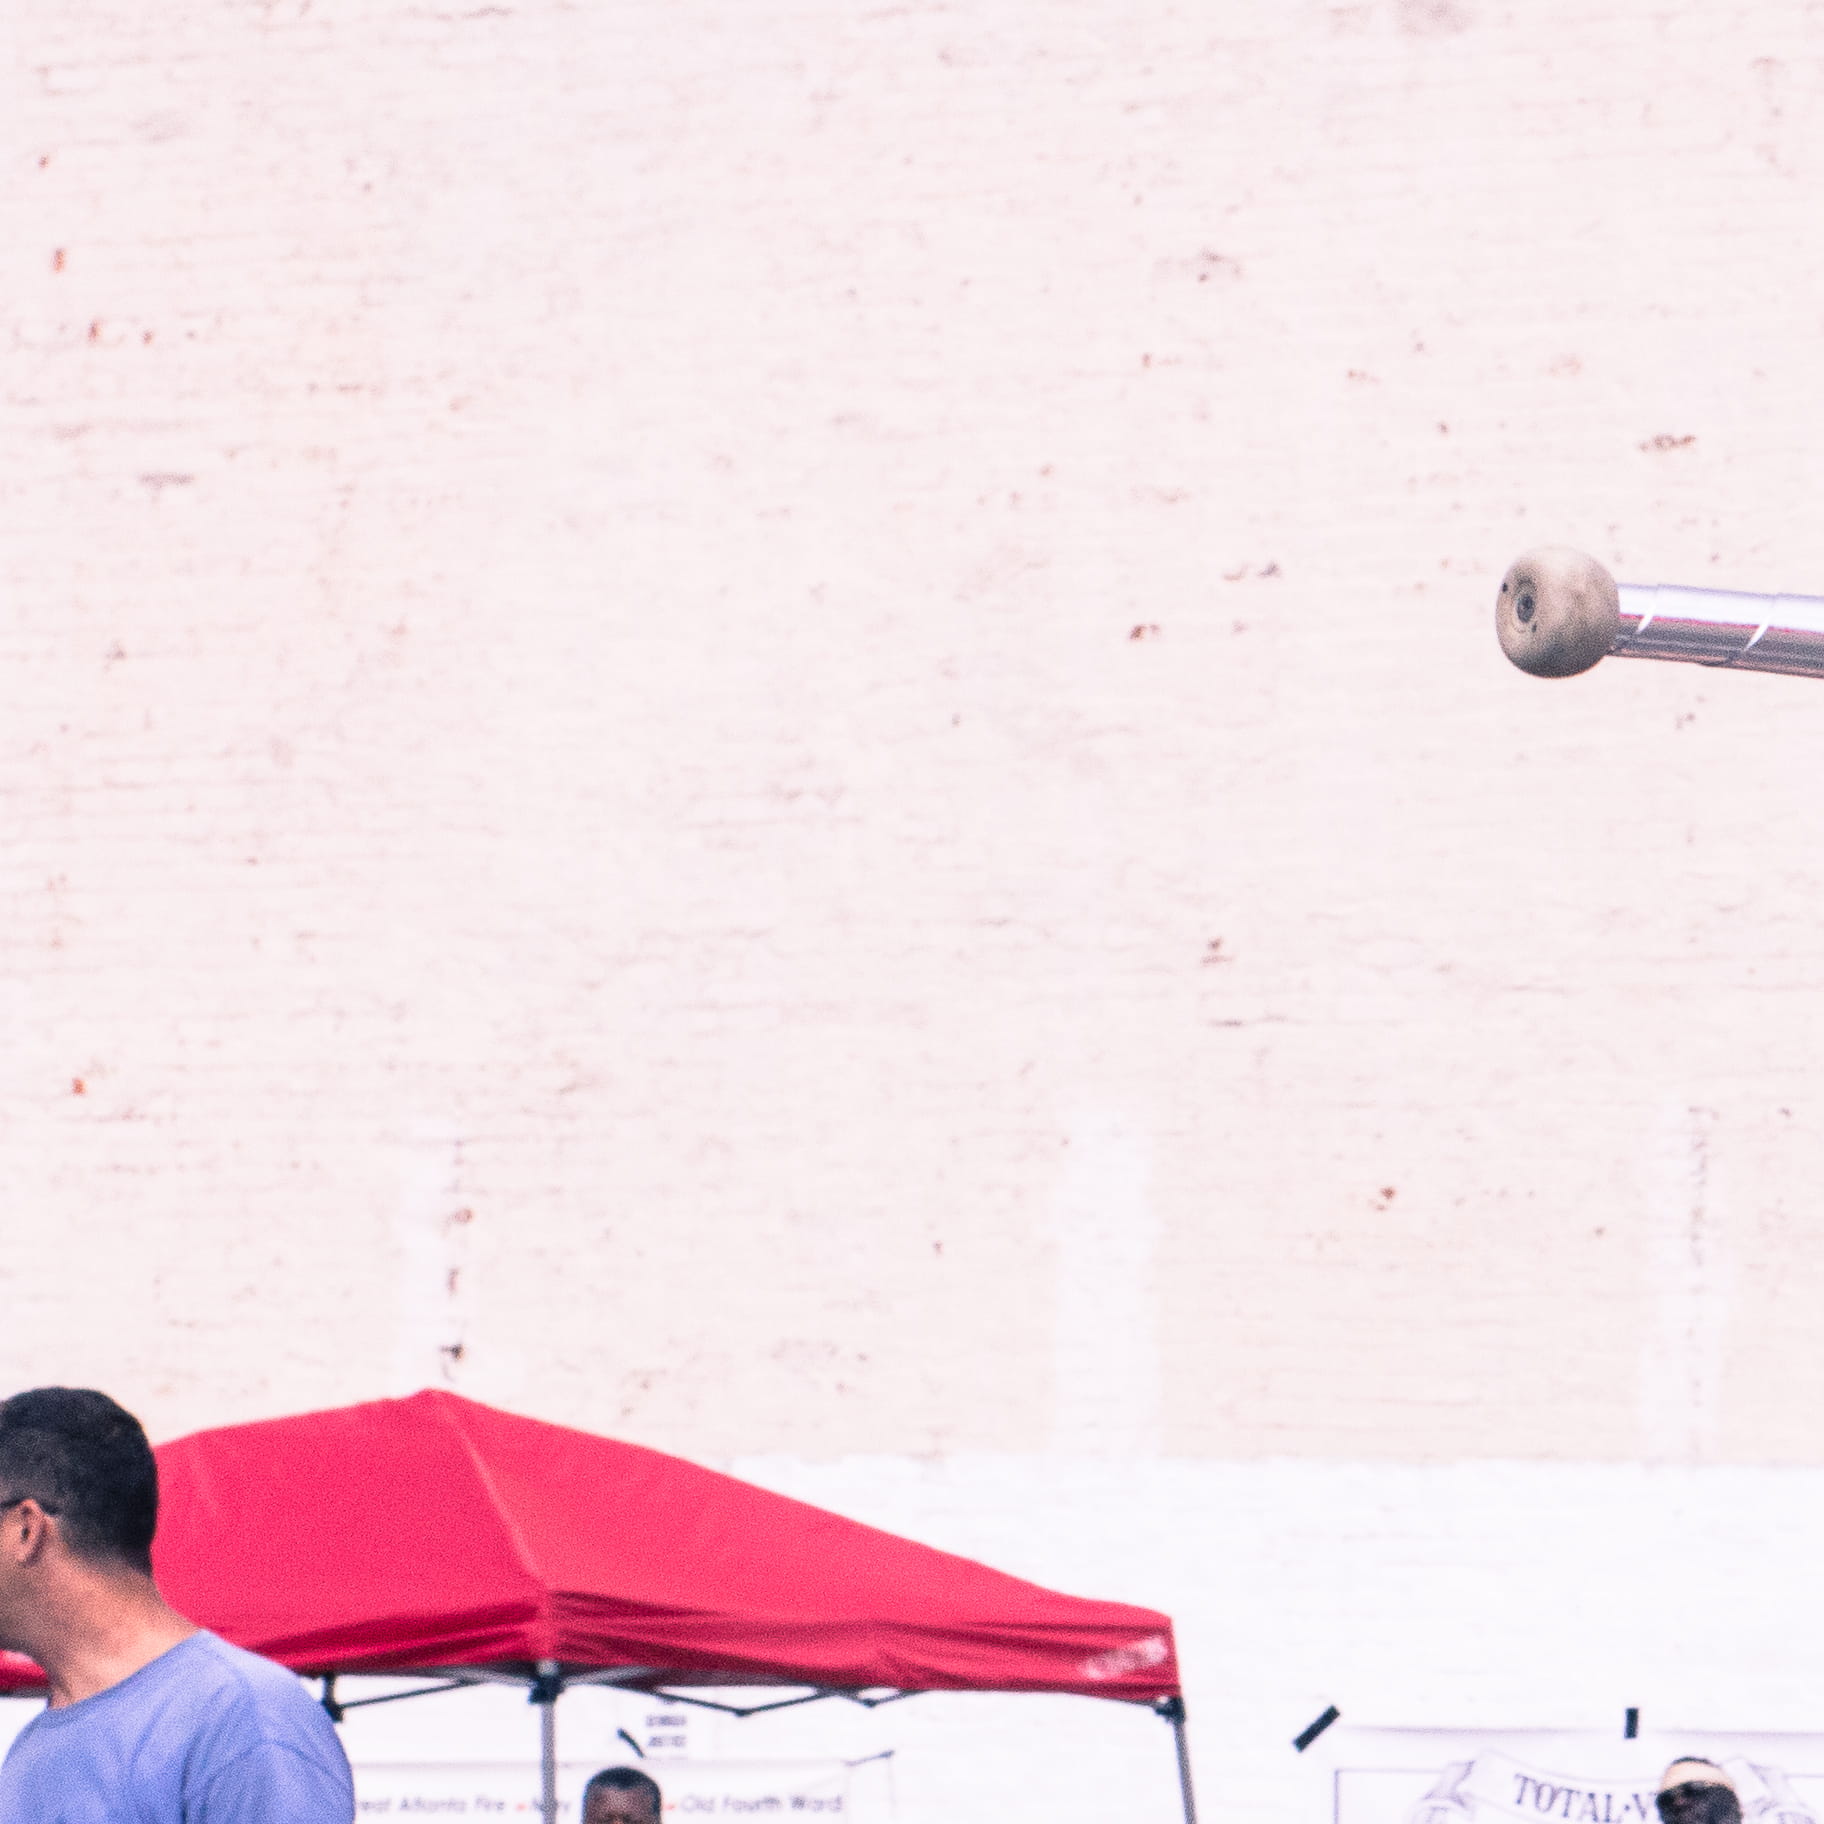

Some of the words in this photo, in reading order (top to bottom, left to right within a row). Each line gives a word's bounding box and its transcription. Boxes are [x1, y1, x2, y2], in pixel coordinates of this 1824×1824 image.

[399, 1797, 467, 1813] Atlanta
[475, 1797, 505, 1813] Fire
[681, 1796, 715, 1812] Old
[723, 1796, 782, 1812] Fourth
[791, 1795, 844, 1812] Ward
